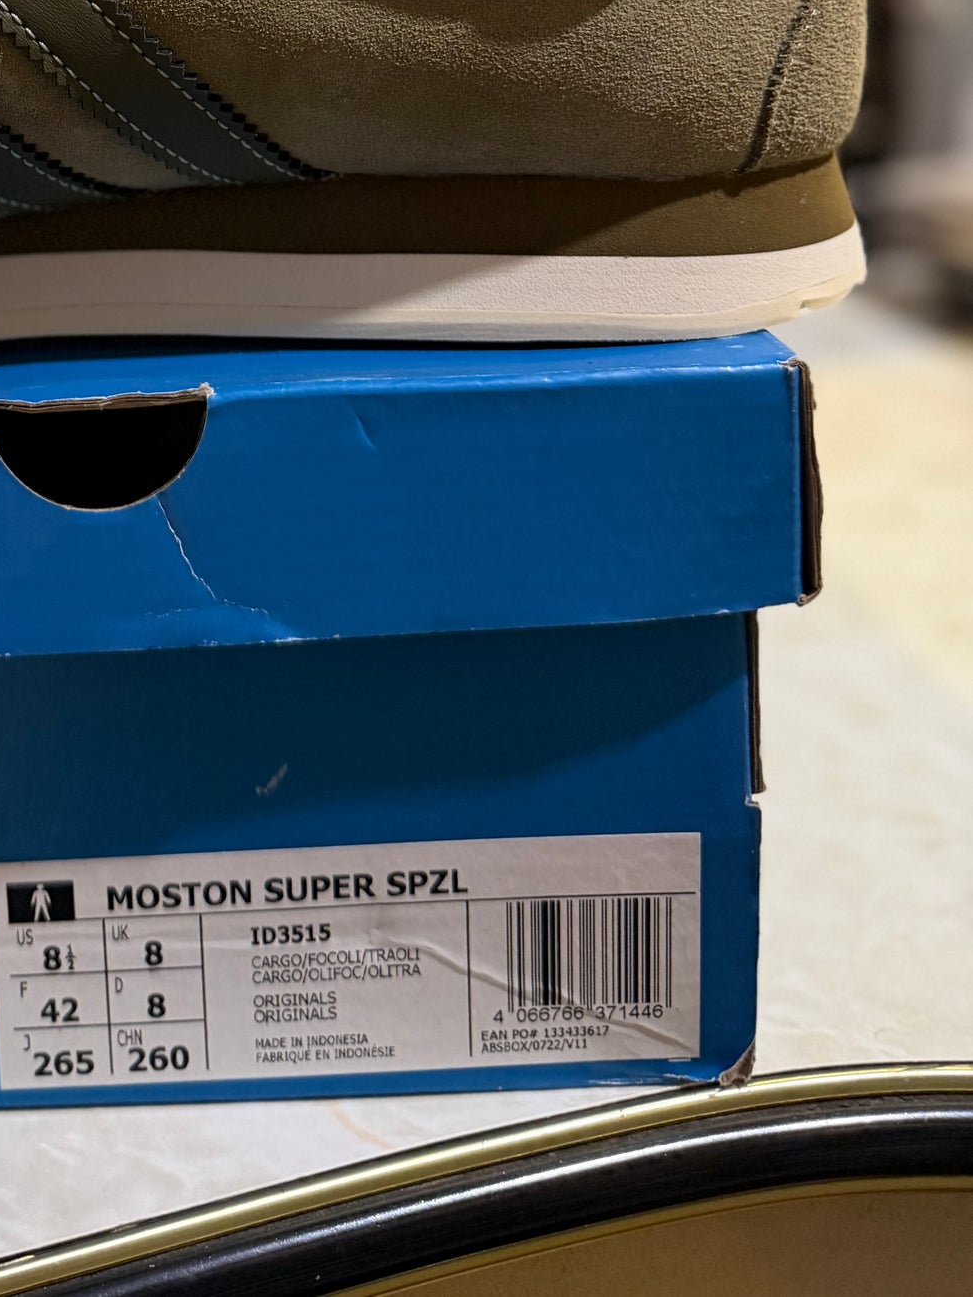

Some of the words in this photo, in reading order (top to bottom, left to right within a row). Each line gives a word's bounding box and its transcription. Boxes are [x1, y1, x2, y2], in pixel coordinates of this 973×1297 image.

[106, 879, 252, 910] MOSTON
[264, 873, 376, 903] SUPER
[386, 868, 469, 897] SPZL
[16, 928, 34, 945] US
[111, 924, 129, 940] UK
[250, 923, 332, 945] ID3515
[144, 940, 164, 966] 8
[251, 948, 421, 969] CARGO/FOCOLI/TRAOLI
[252, 963, 422, 985] CARGO/OLIFOC/OLITRA
[19, 981, 28, 998] F
[115, 977, 124, 994] D
[146, 993, 167, 1019] 8
[253, 991, 337, 1008] ORIGINALS
[40, 997, 80, 1023] 42
[253, 1006, 338, 1024] ORIGINALS
[493, 1009, 503, 1023] 4
[516, 1006, 585, 1023] 066766
[595, 1004, 664, 1021] 371446
[116, 1028, 143, 1046] CHN
[255, 1036, 286, 1049] MADE
[291, 1035, 303, 1046] IN
[307, 1033, 369, 1046] INDONESIA
[481, 1029, 508, 1042] EAN
[512, 1028, 538, 1040] PO#
[544, 1025, 610, 1039] 133433617
[23, 1034, 32, 1052] J
[128, 1045, 190, 1072] 260
[315, 1049, 330, 1061] EN
[334, 1044, 396, 1060] INDONÉSIE
[33, 1050, 95, 1077] 265
